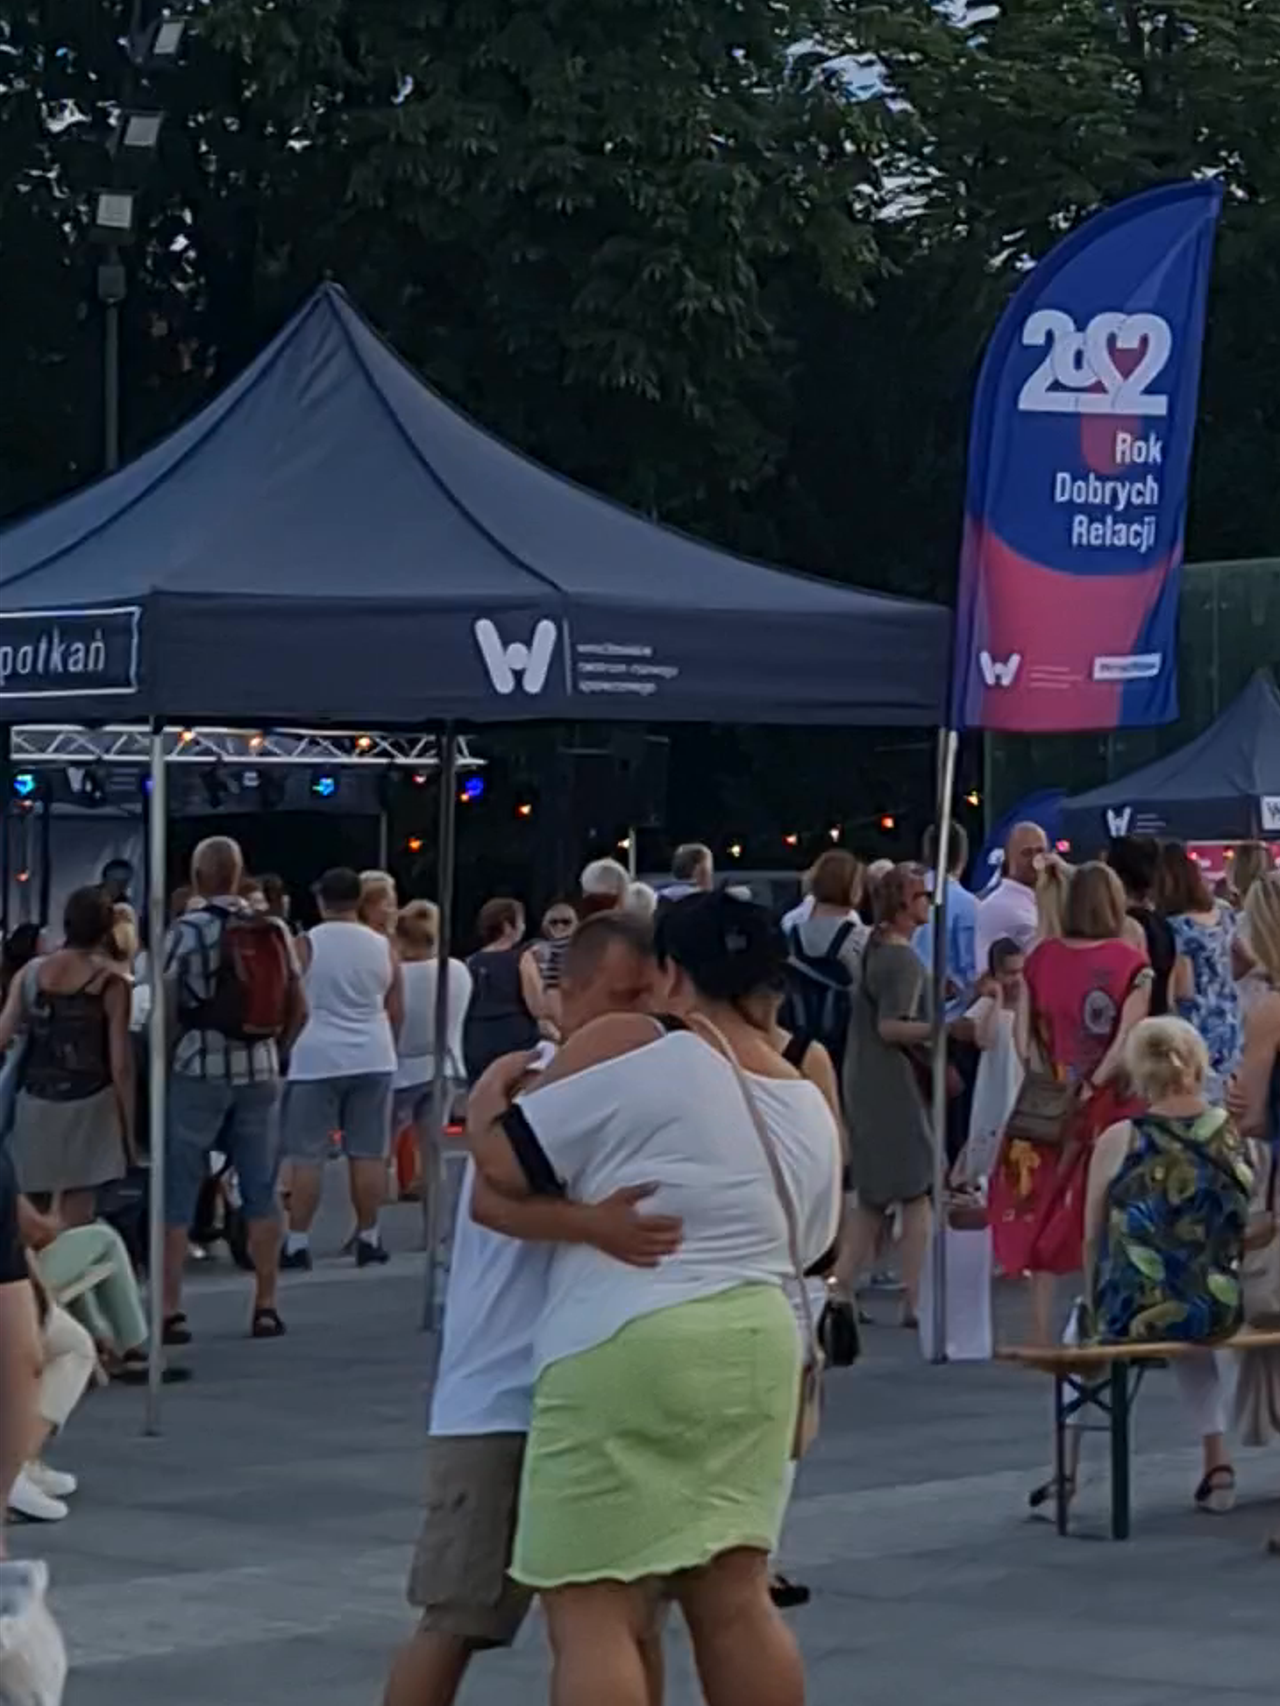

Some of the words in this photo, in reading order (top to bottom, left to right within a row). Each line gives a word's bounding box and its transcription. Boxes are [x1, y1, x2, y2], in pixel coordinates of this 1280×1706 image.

[1115, 432, 1161, 463] Rok
[1055, 473, 1158, 510] Dobrych
[1072, 514, 1156, 552] Relacji
